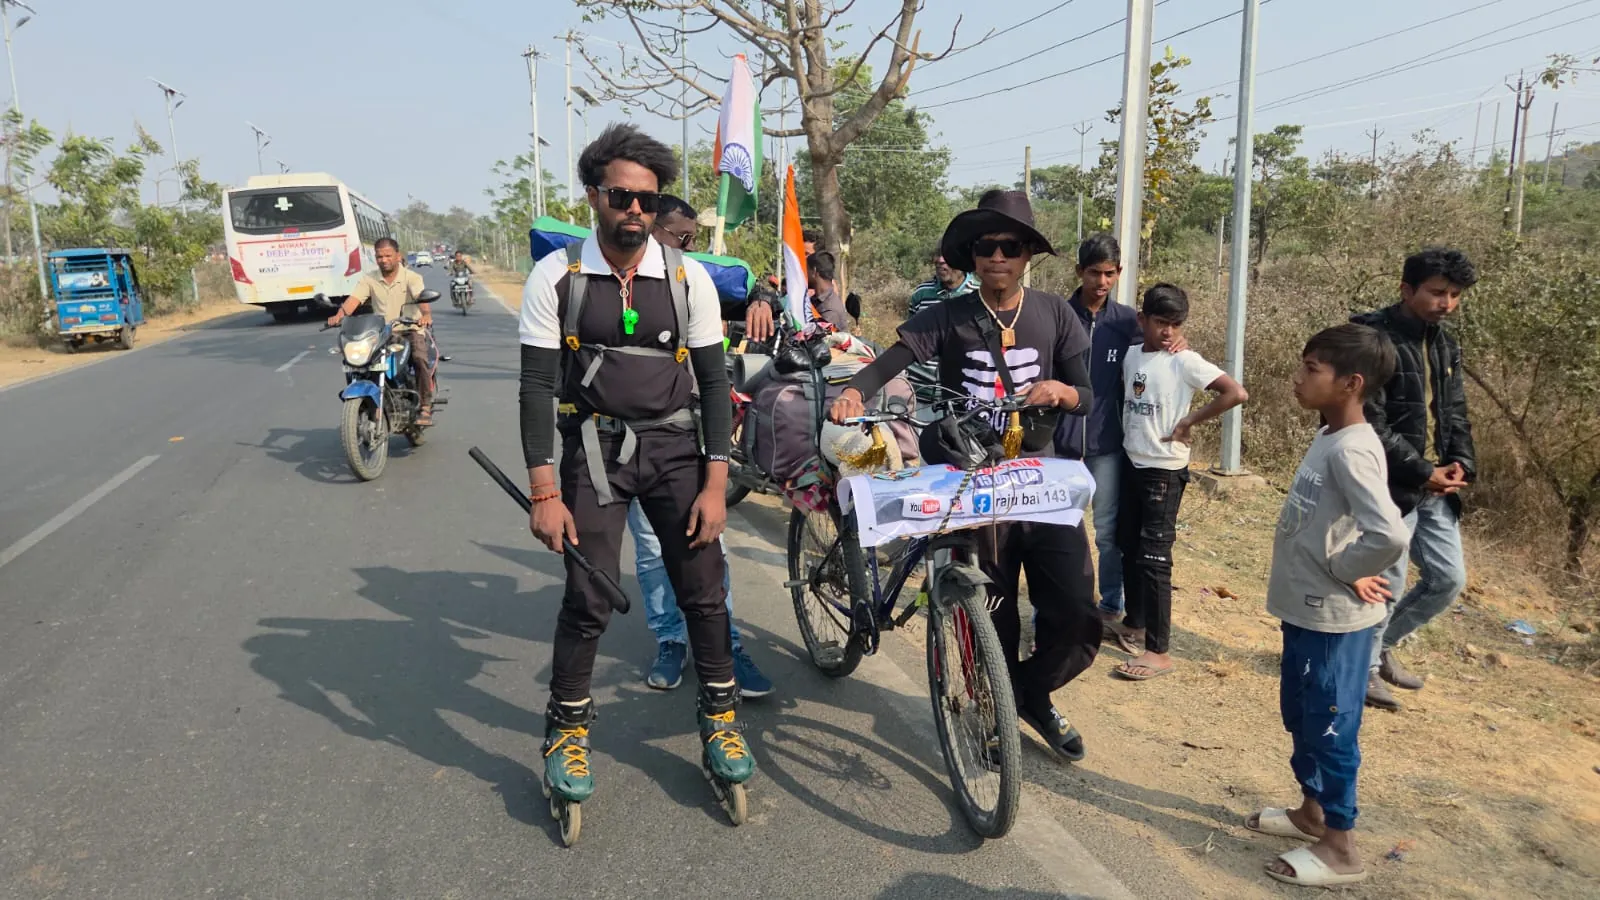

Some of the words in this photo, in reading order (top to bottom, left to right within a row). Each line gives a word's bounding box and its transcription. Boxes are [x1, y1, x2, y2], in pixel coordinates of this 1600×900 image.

[995, 494, 1018, 508] raju
[1022, 492, 1040, 506] bai
[1044, 489, 1067, 503] 143
